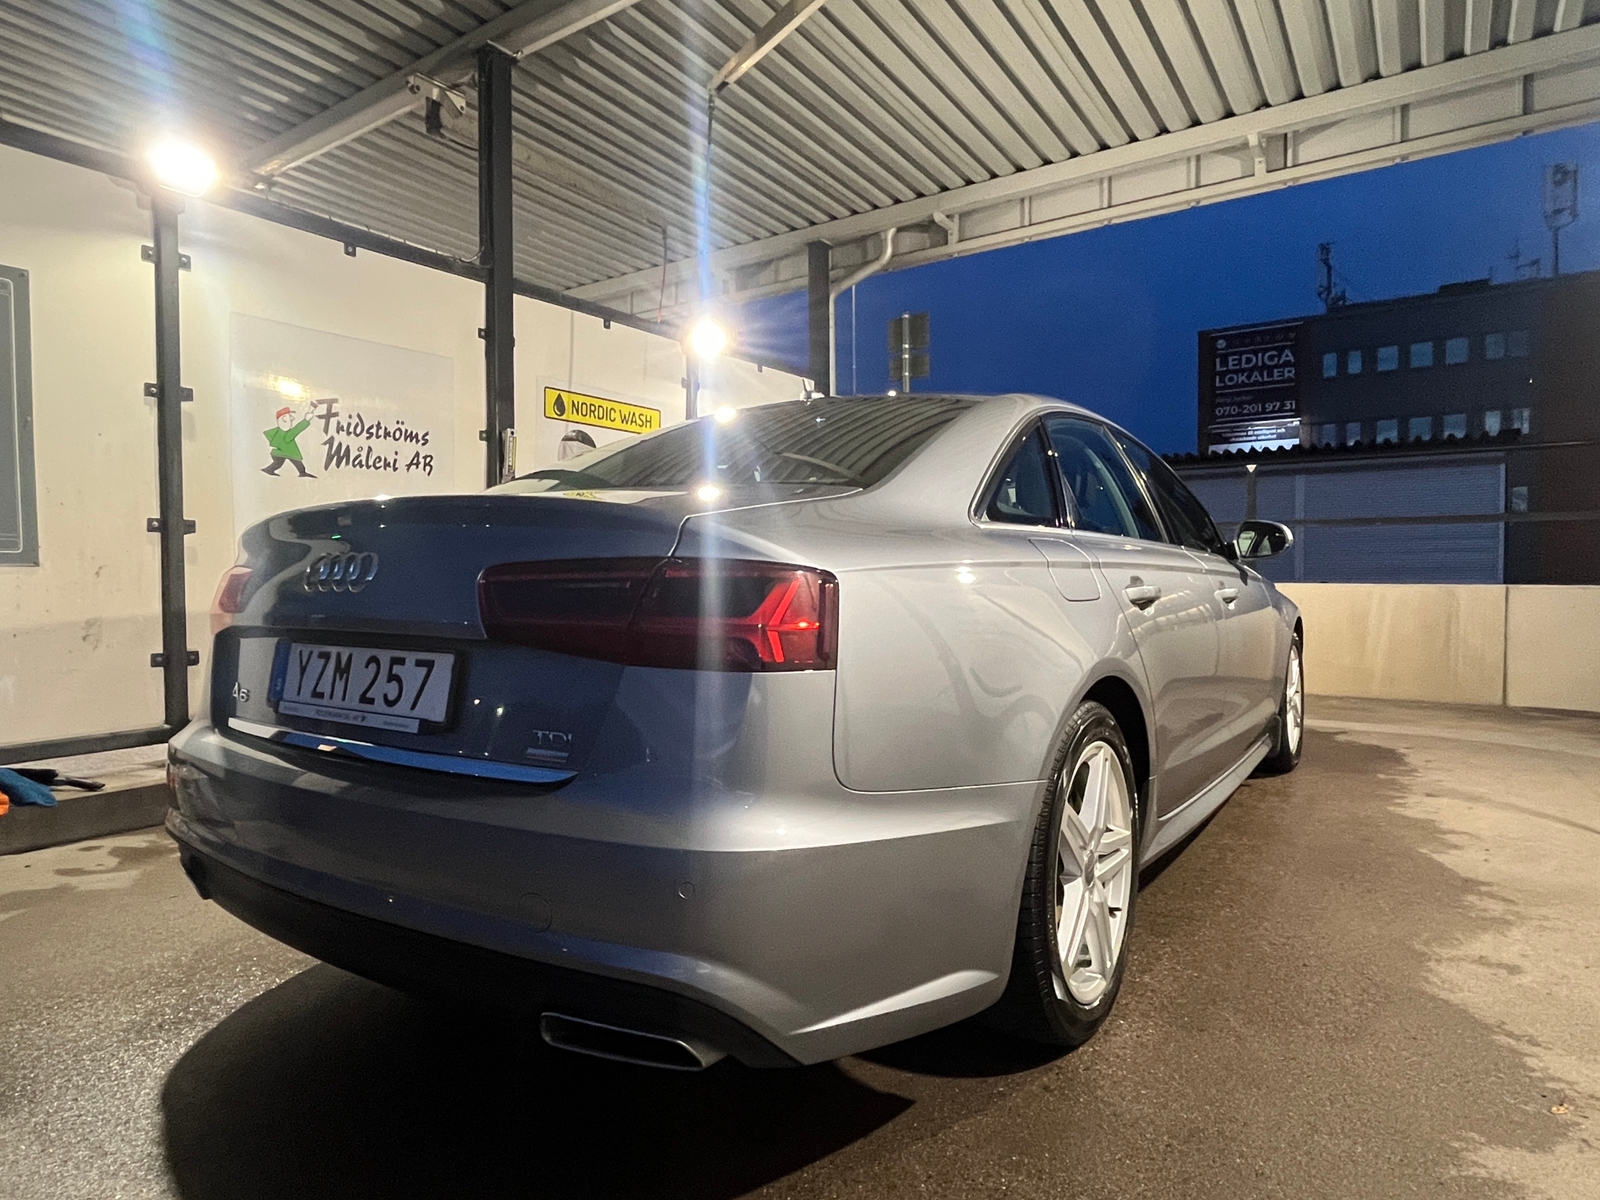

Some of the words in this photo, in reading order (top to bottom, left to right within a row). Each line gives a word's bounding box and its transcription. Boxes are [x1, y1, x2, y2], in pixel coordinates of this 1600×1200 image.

[1215, 348, 1295, 371] LEDIGA
[1215, 367, 1295, 387] LOKALER
[571, 400, 617, 423] NORDIC
[619, 409, 653, 429] WASH
[1215, 403, 1262, 416] 070-201
[1265, 402, 1280, 412] 97
[1283, 400, 1296, 410] 31
[315, 398, 430, 446] Fridströms
[321, 435, 399, 471] Måleri
[230, 681, 249, 702] A6
[296, 650, 353, 701] YZM
[358, 655, 436, 711] 257
